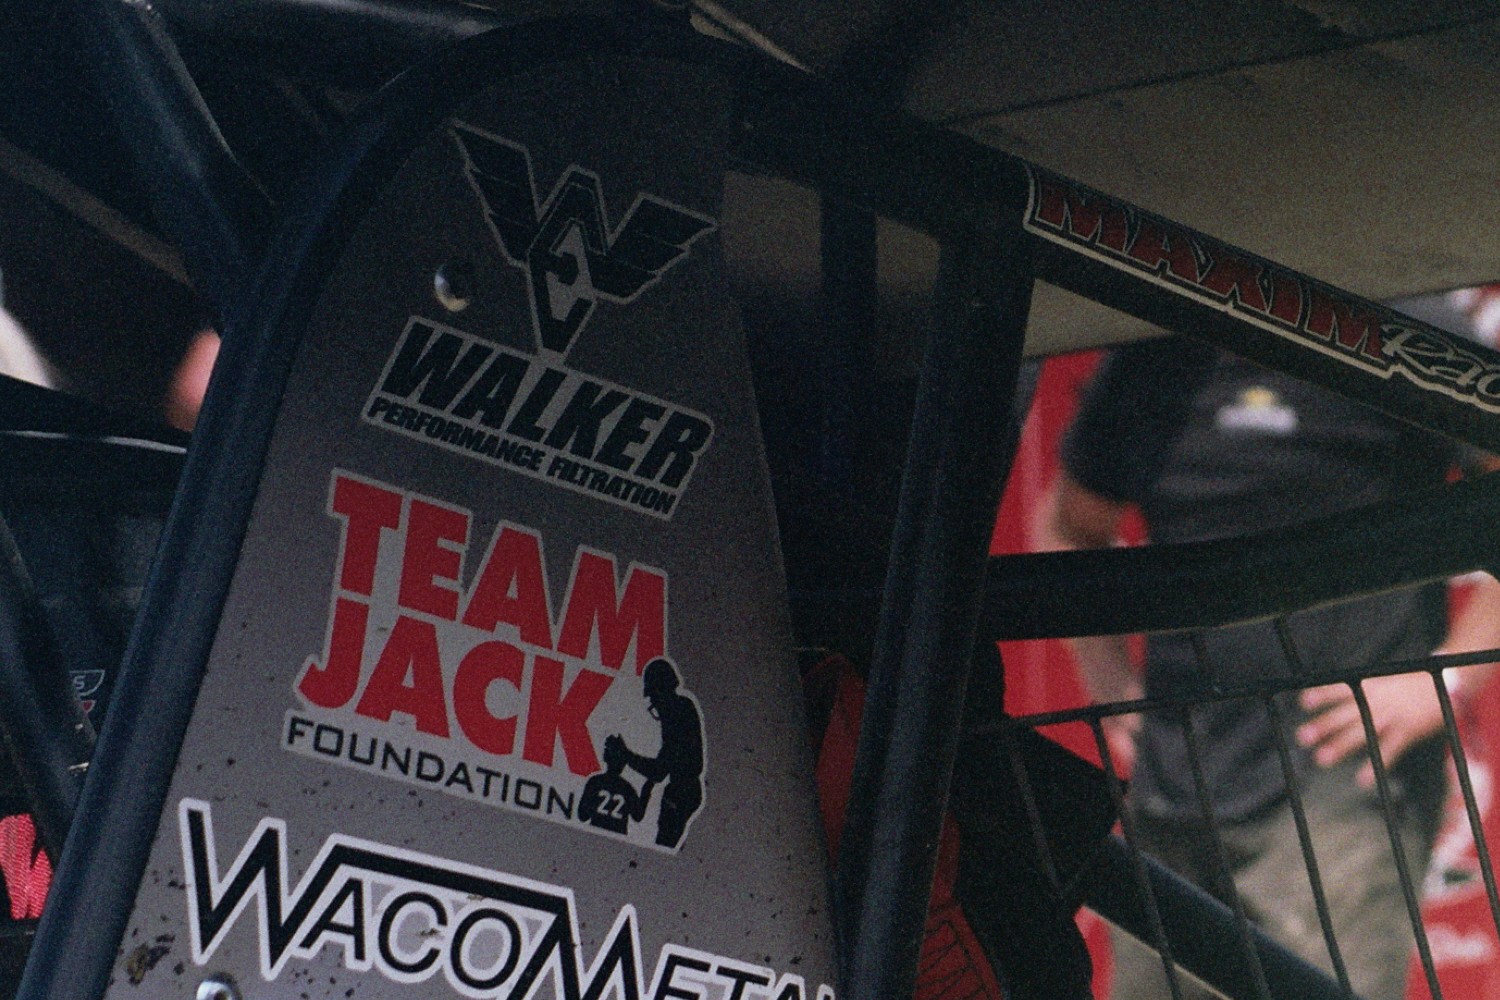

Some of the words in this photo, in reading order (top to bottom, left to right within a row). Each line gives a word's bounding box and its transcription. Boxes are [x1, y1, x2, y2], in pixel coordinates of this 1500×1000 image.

[1033, 180, 1389, 368] MAXIM
[367, 396, 547, 474] PERFORMANCE
[547, 456, 678, 515] FILTRATION
[381, 321, 712, 490] WALKER
[332, 475, 667, 677] TEAM
[287, 716, 575, 820] FOUNDATION
[298, 597, 616, 777] JACK
[596, 789, 625, 820] 22
